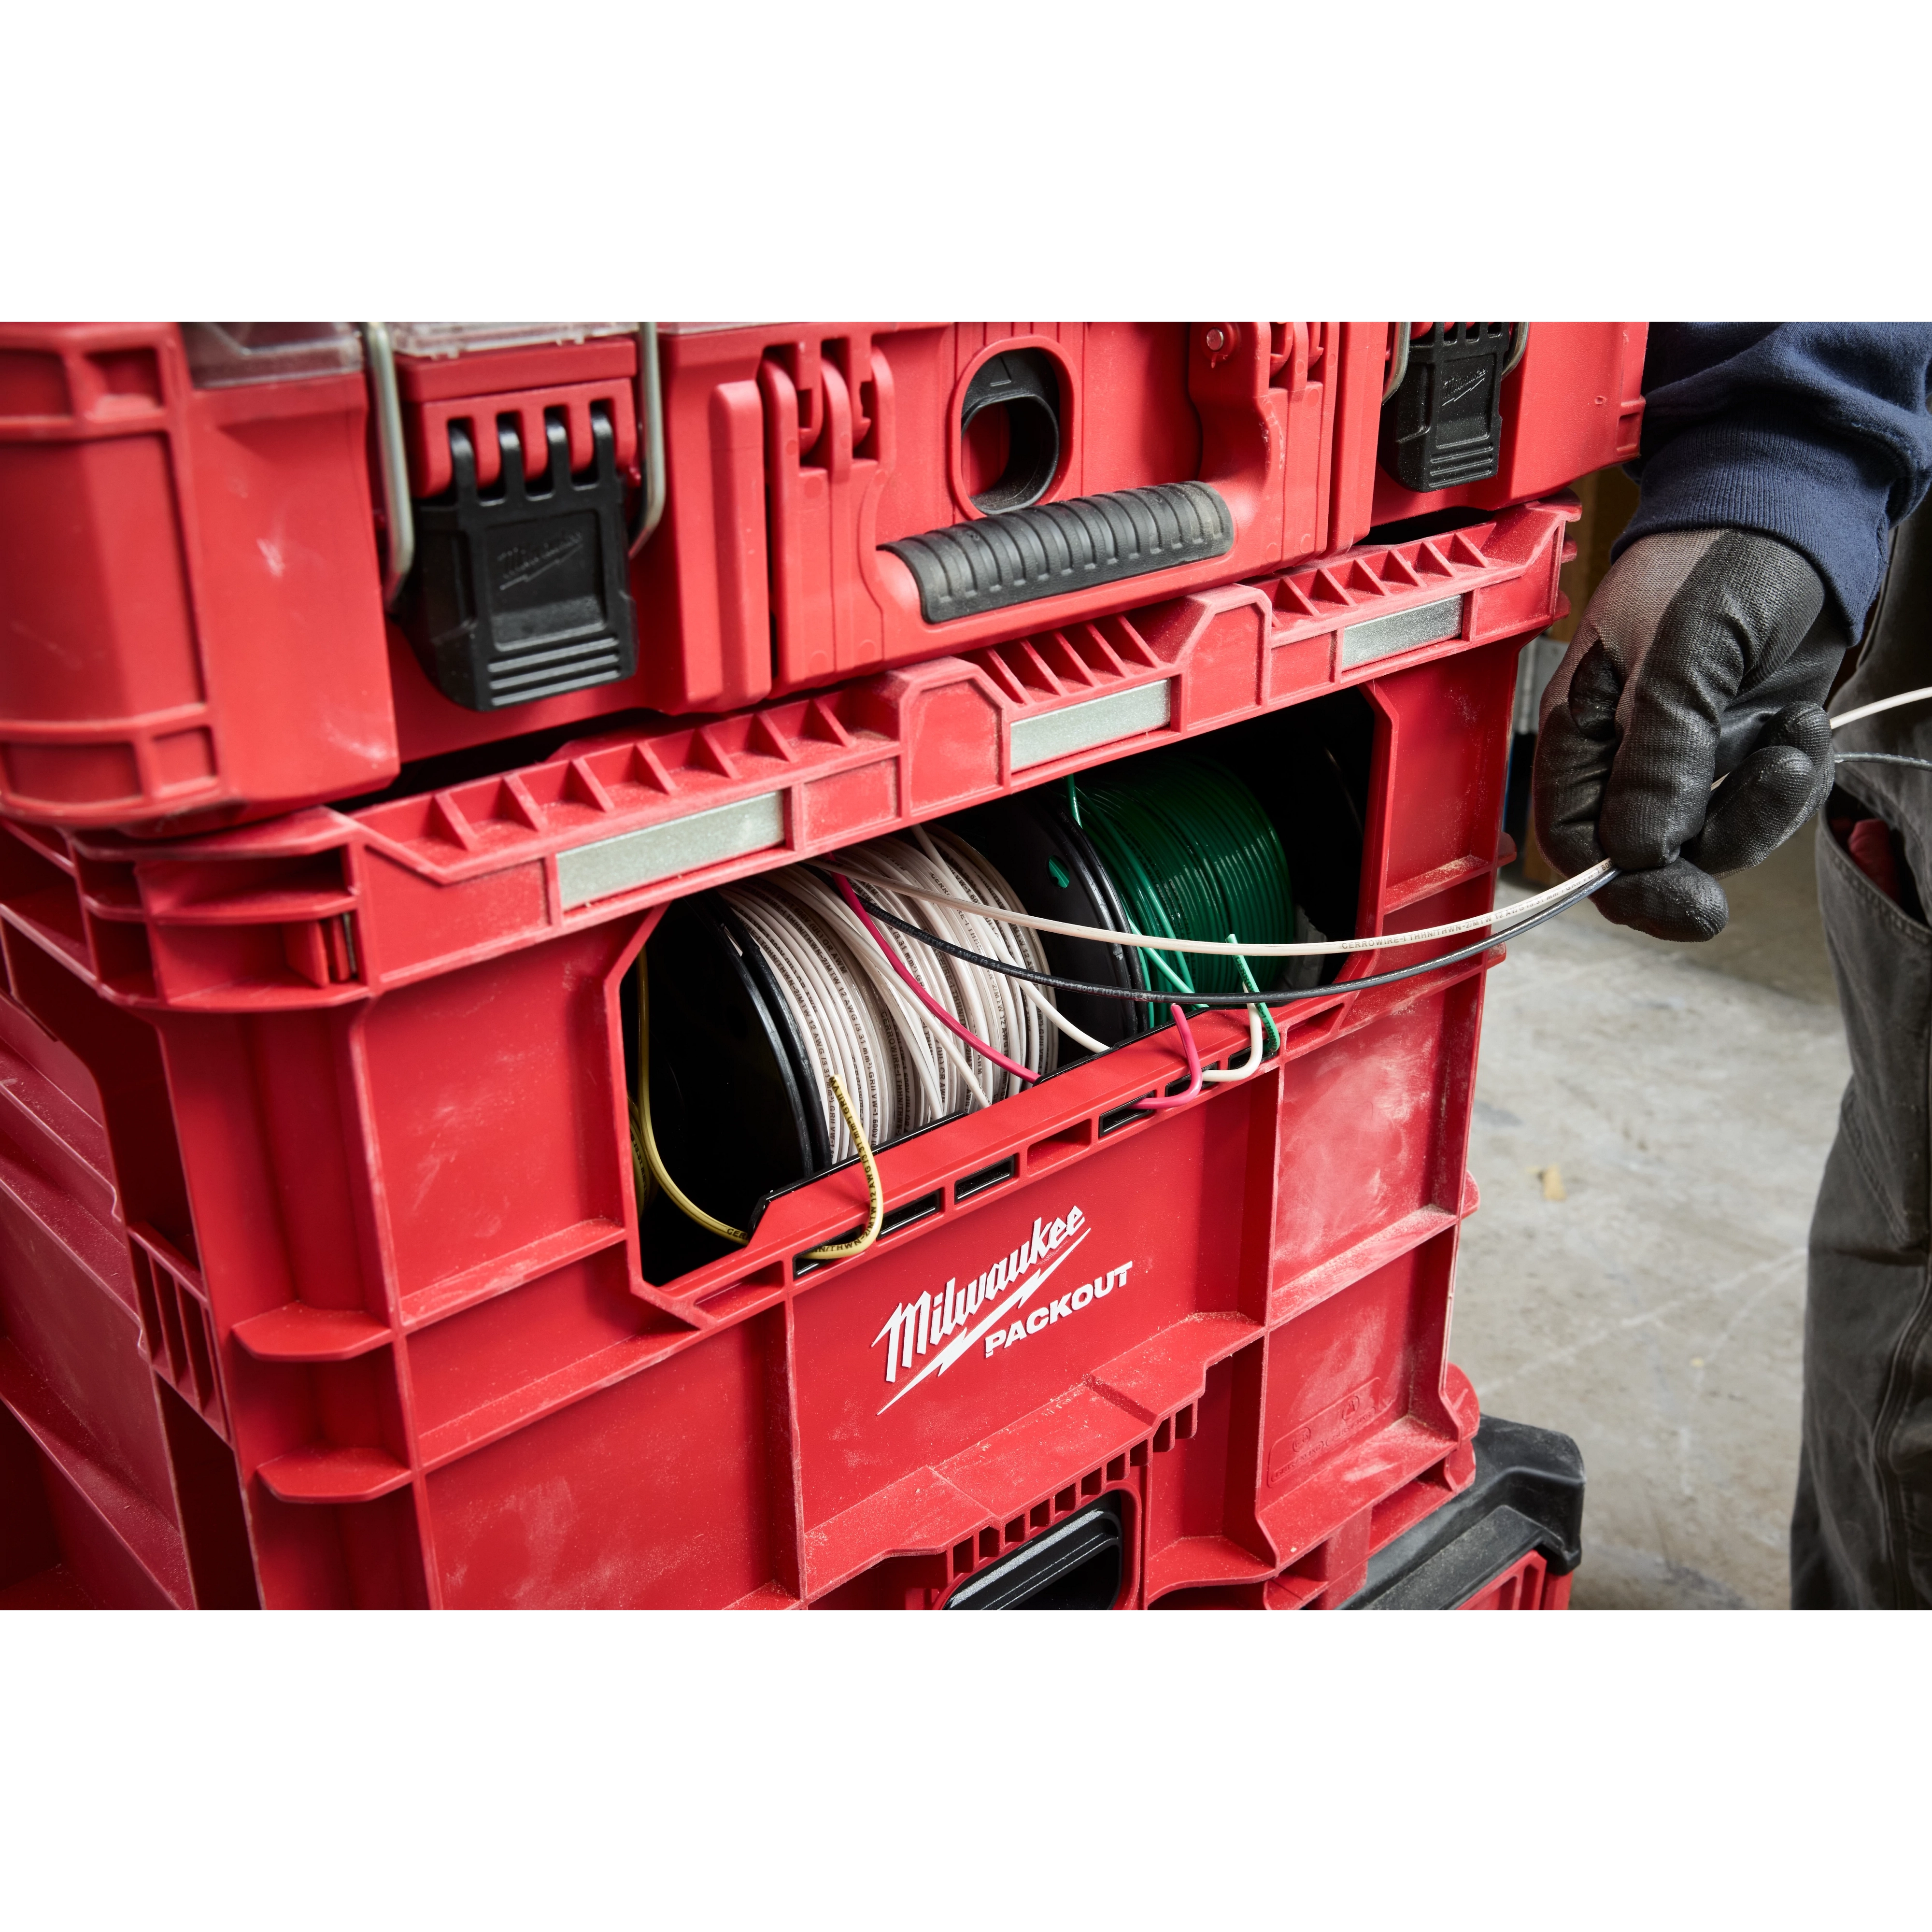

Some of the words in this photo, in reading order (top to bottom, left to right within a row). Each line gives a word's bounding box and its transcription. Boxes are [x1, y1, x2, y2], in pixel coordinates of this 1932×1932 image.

[1342, 934, 1407, 950] CERROWIRE-I
[1409, 915, 1492, 941] THHN/THWN-2/MTW
[1504, 904, 1524, 916] AWG
[1600, 859, 1614, 871] 600
[785, 913, 840, 985] THHN/THWN-2/MTW
[838, 986, 847, 997] 12
[843, 998, 857, 1022] AWG
[821, 938, 834, 952] OR
[830, 952, 848, 974] AWM
[1022, 948, 1030, 958] 12
[945, 944, 955, 953] 12
[957, 949, 978, 962] AWG
[1140, 993, 1165, 1001] AWM
[808, 1019, 816, 1030] 12
[812, 1031, 824, 1055] AWG
[999, 1015, 1006, 1024] 12
[880, 1010, 901, 1076] CERROWIRE-I
[975, 1054, 983, 1074] AWM
[863, 1165, 875, 1189] AWG
[870, 1191, 877, 1201] 12
[871, 1205, 1085, 1383] Milwaukee
[985, 1260, 1133, 1358] PACKOUT
